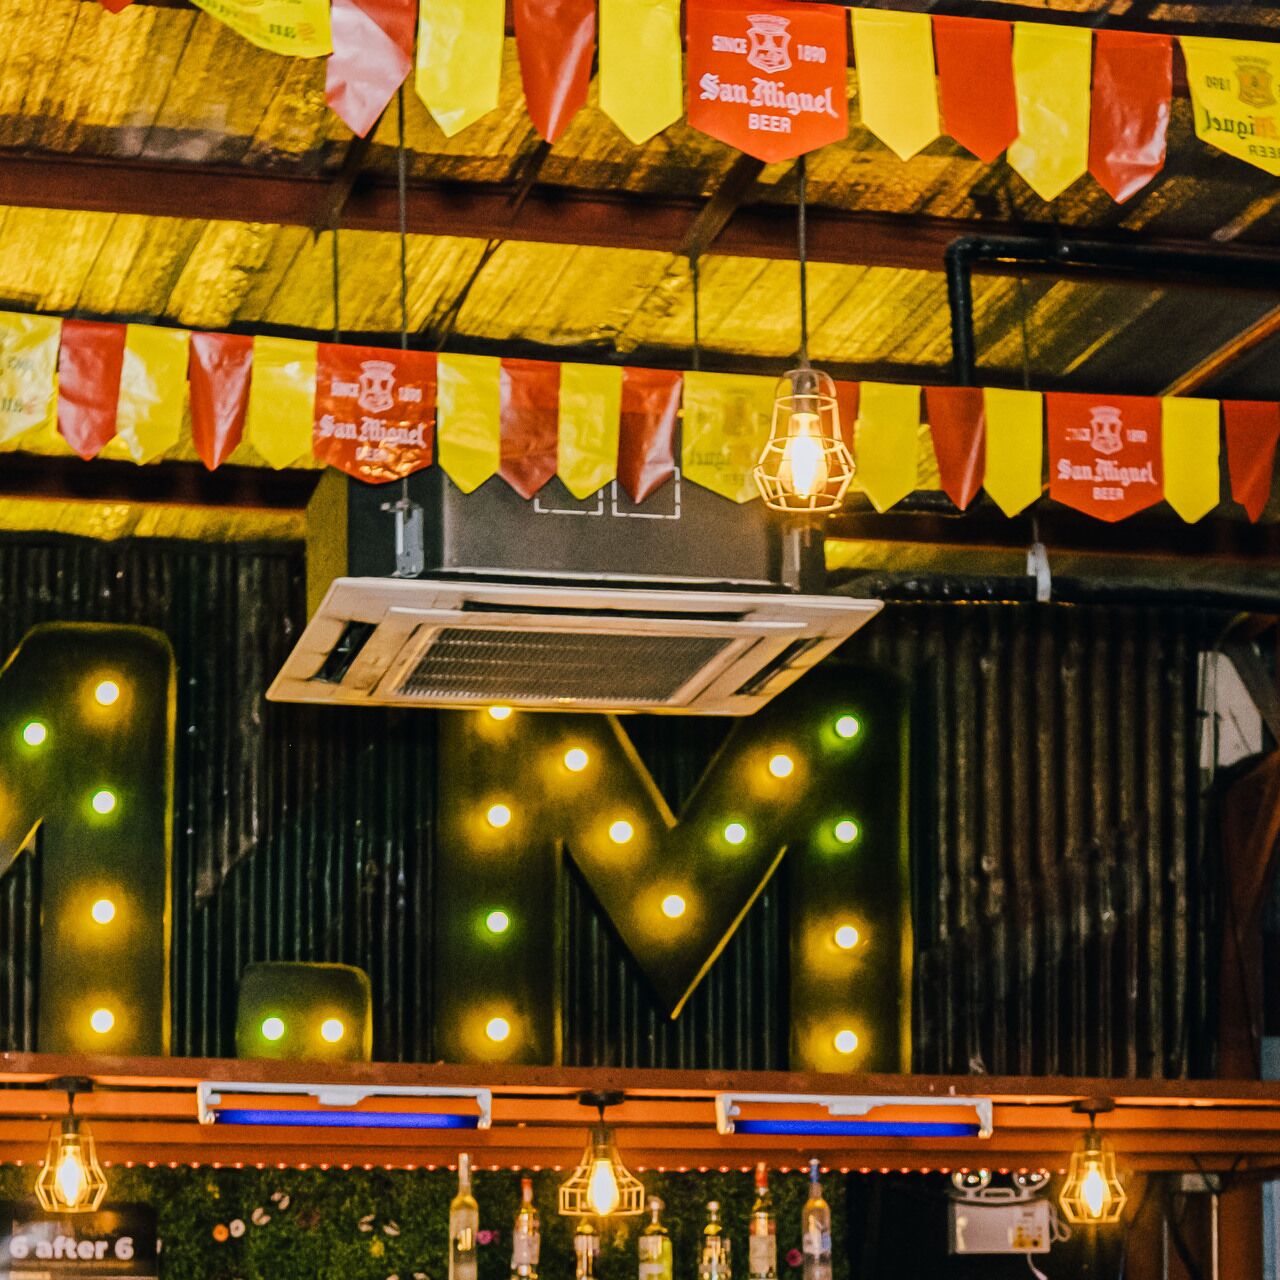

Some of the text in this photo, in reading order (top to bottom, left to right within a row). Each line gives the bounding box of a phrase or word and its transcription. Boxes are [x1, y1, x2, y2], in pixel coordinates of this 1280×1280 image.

[712, 35, 747, 54] SINCE
[699, 73, 839, 118] San Miguel
[748, 113, 791, 133] BEER
[319, 414, 427, 448] San Miguel
[1057, 458, 1158, 487] San Miguel
[9, 1235, 134, 1260] 6 after 6
